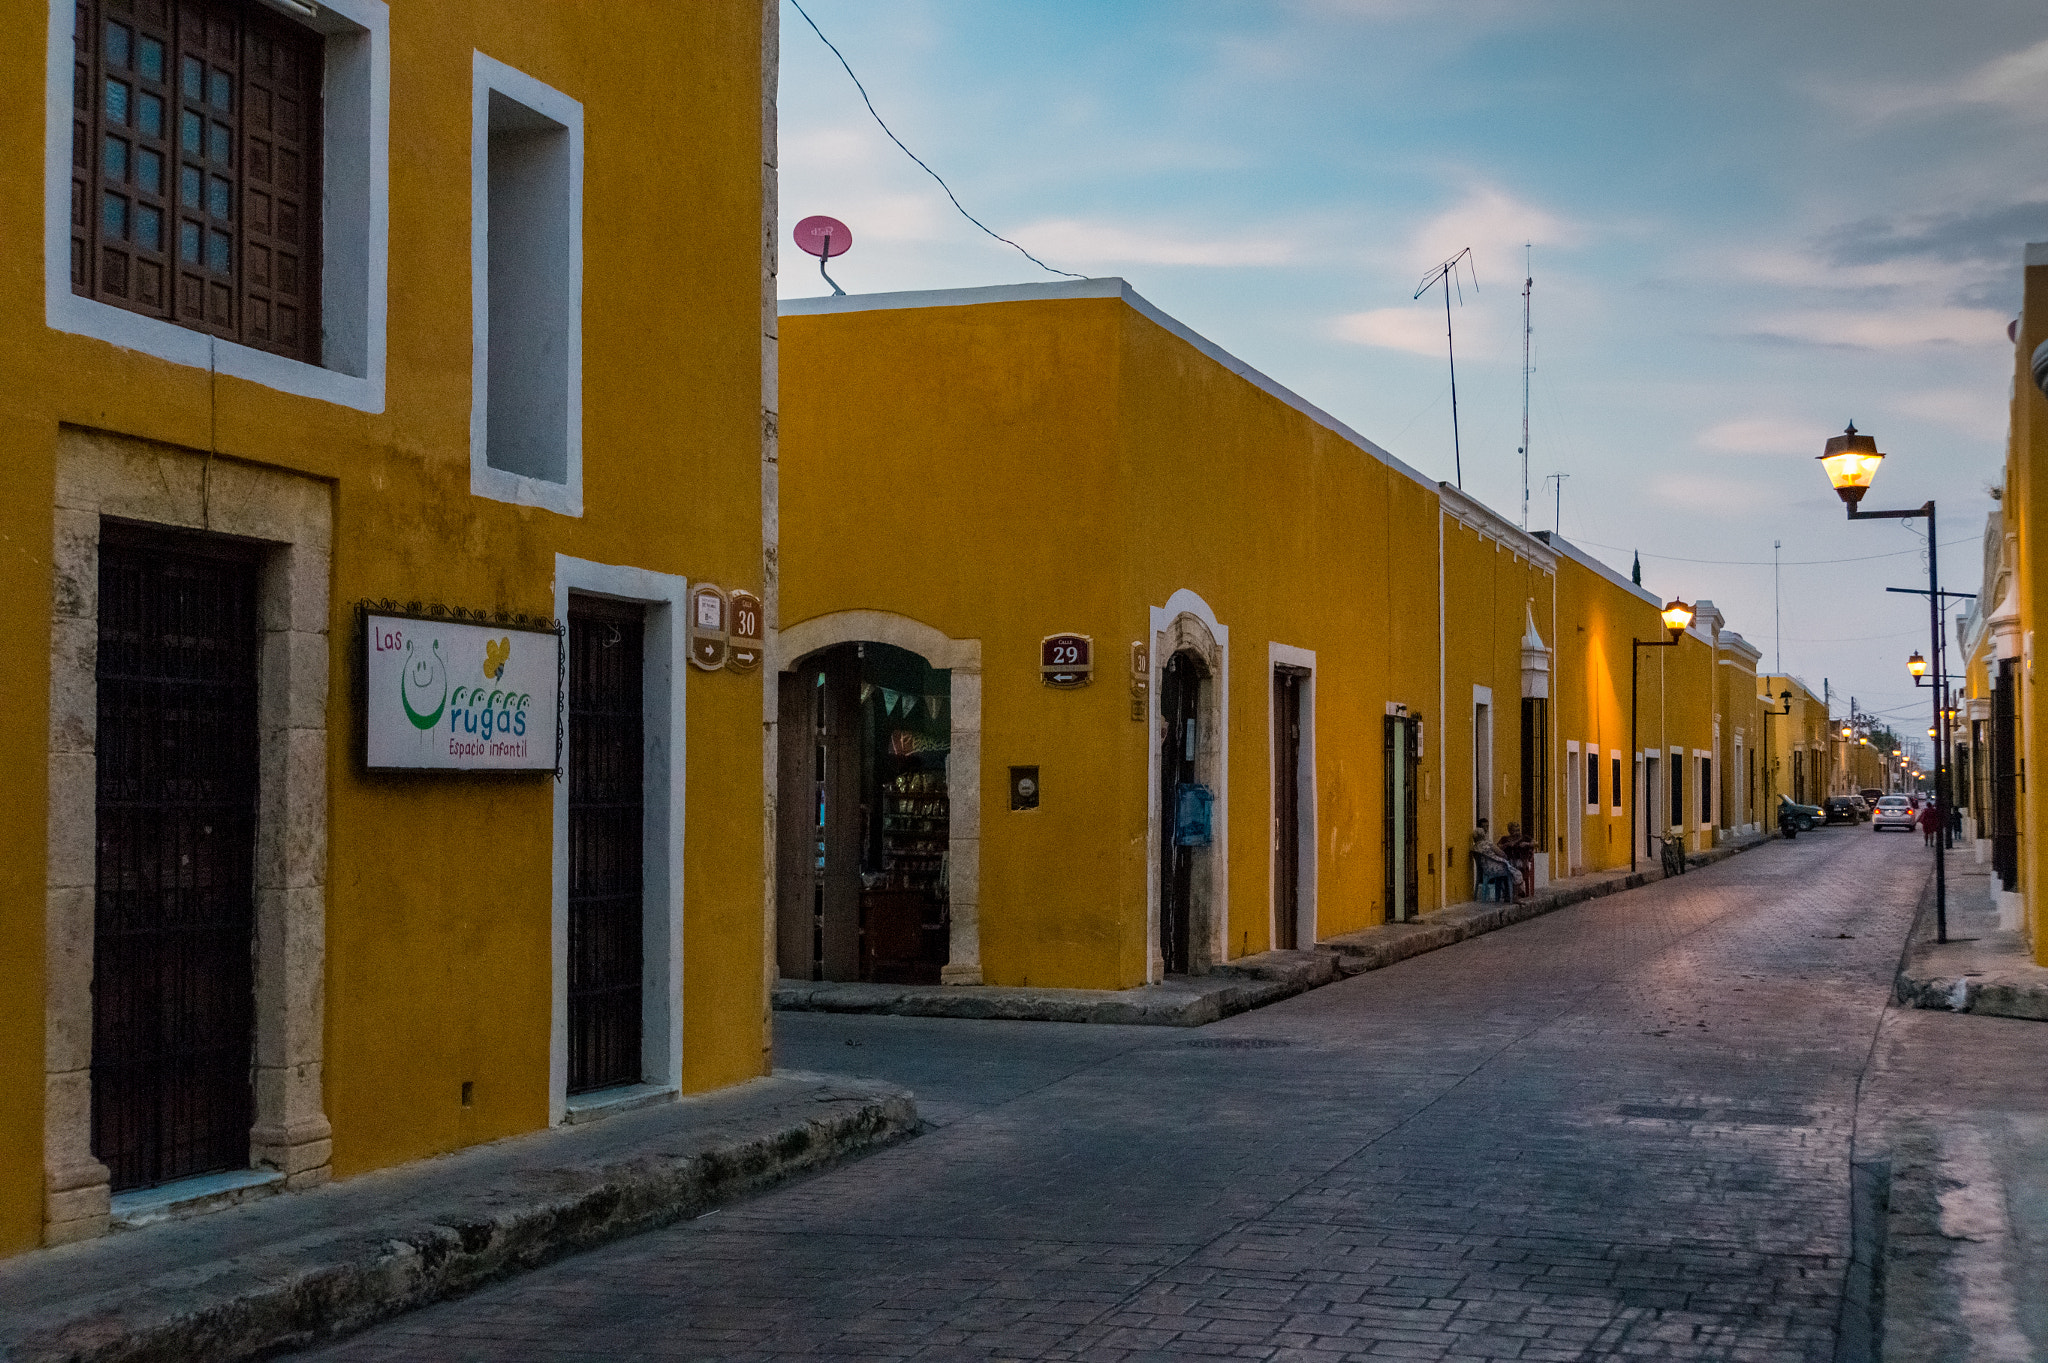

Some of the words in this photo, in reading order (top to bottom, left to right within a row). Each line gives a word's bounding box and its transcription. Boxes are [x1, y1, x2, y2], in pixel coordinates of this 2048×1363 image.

[738, 610, 755, 636] 30
[375, 626, 402, 652] Las
[1053, 646, 1078, 664] 29
[1137, 654, 1146, 672] 30
[449, 738, 485, 758] Espacio
[489, 739, 527, 758] infantil
